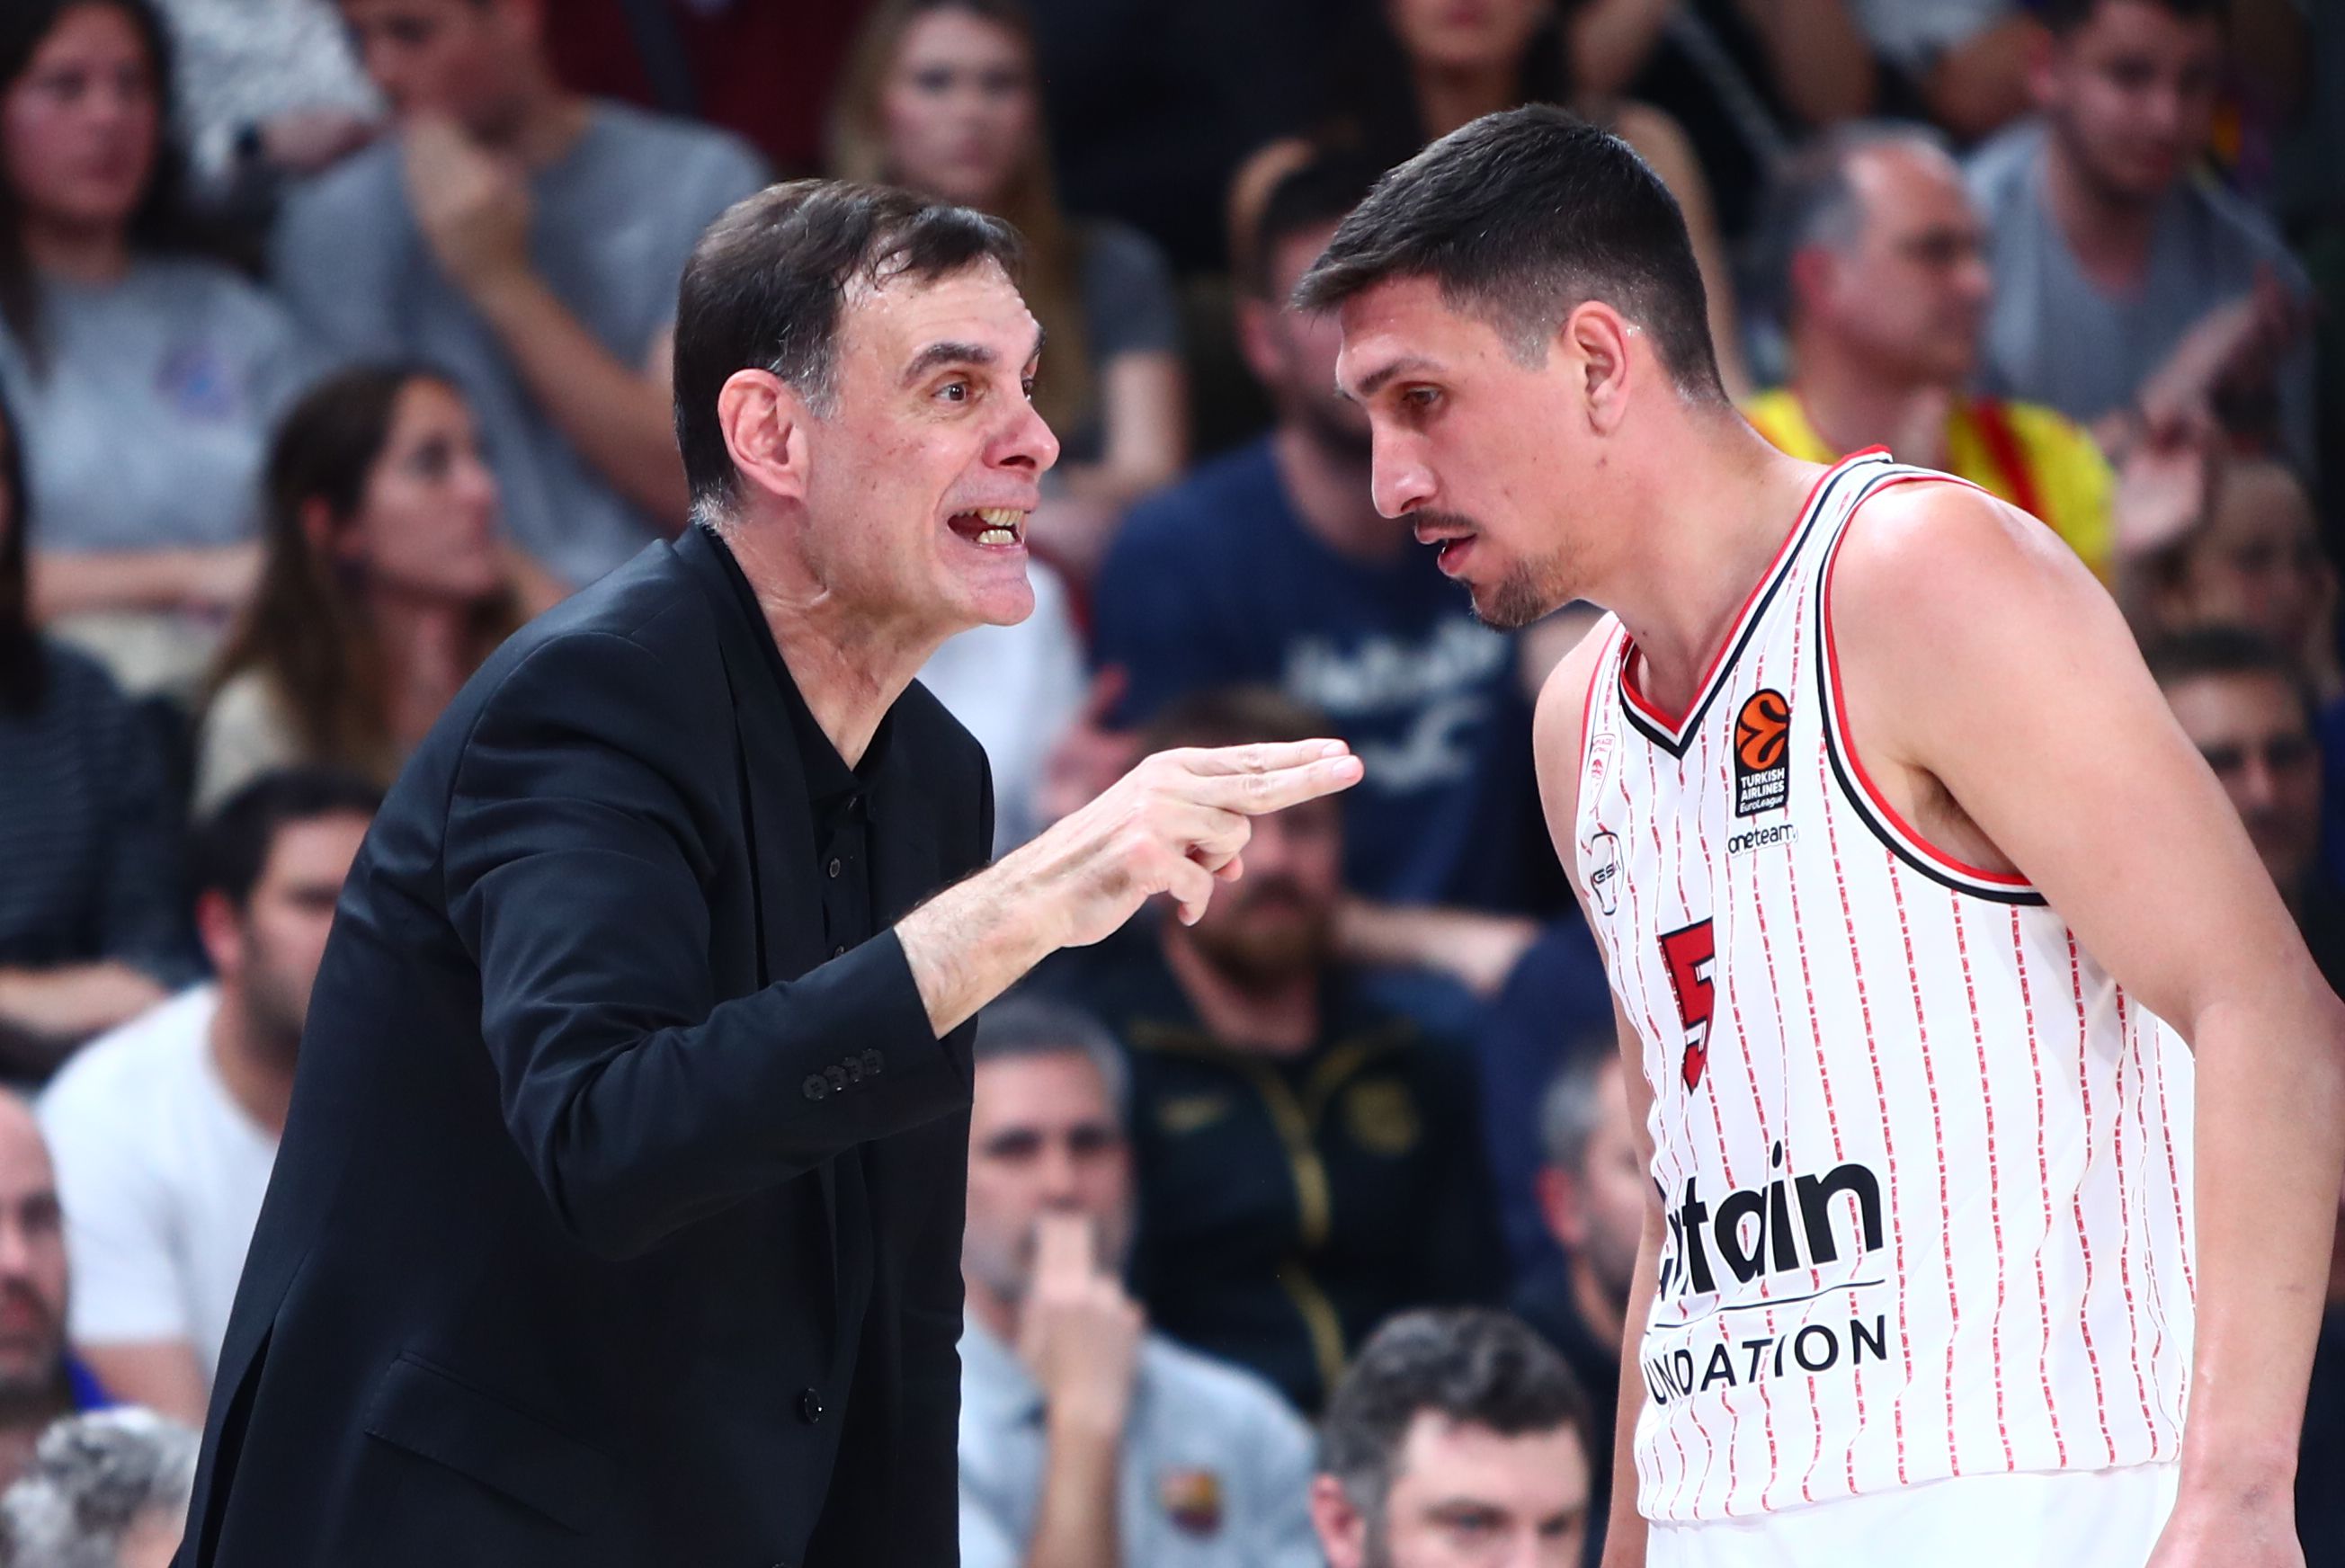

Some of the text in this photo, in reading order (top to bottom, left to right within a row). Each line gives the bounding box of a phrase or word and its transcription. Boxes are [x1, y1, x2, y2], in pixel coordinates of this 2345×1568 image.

[1741, 767, 1785, 788] TURKISH
[1741, 780, 1785, 802] AIRLINES
[1660, 916, 1716, 1096] 5
